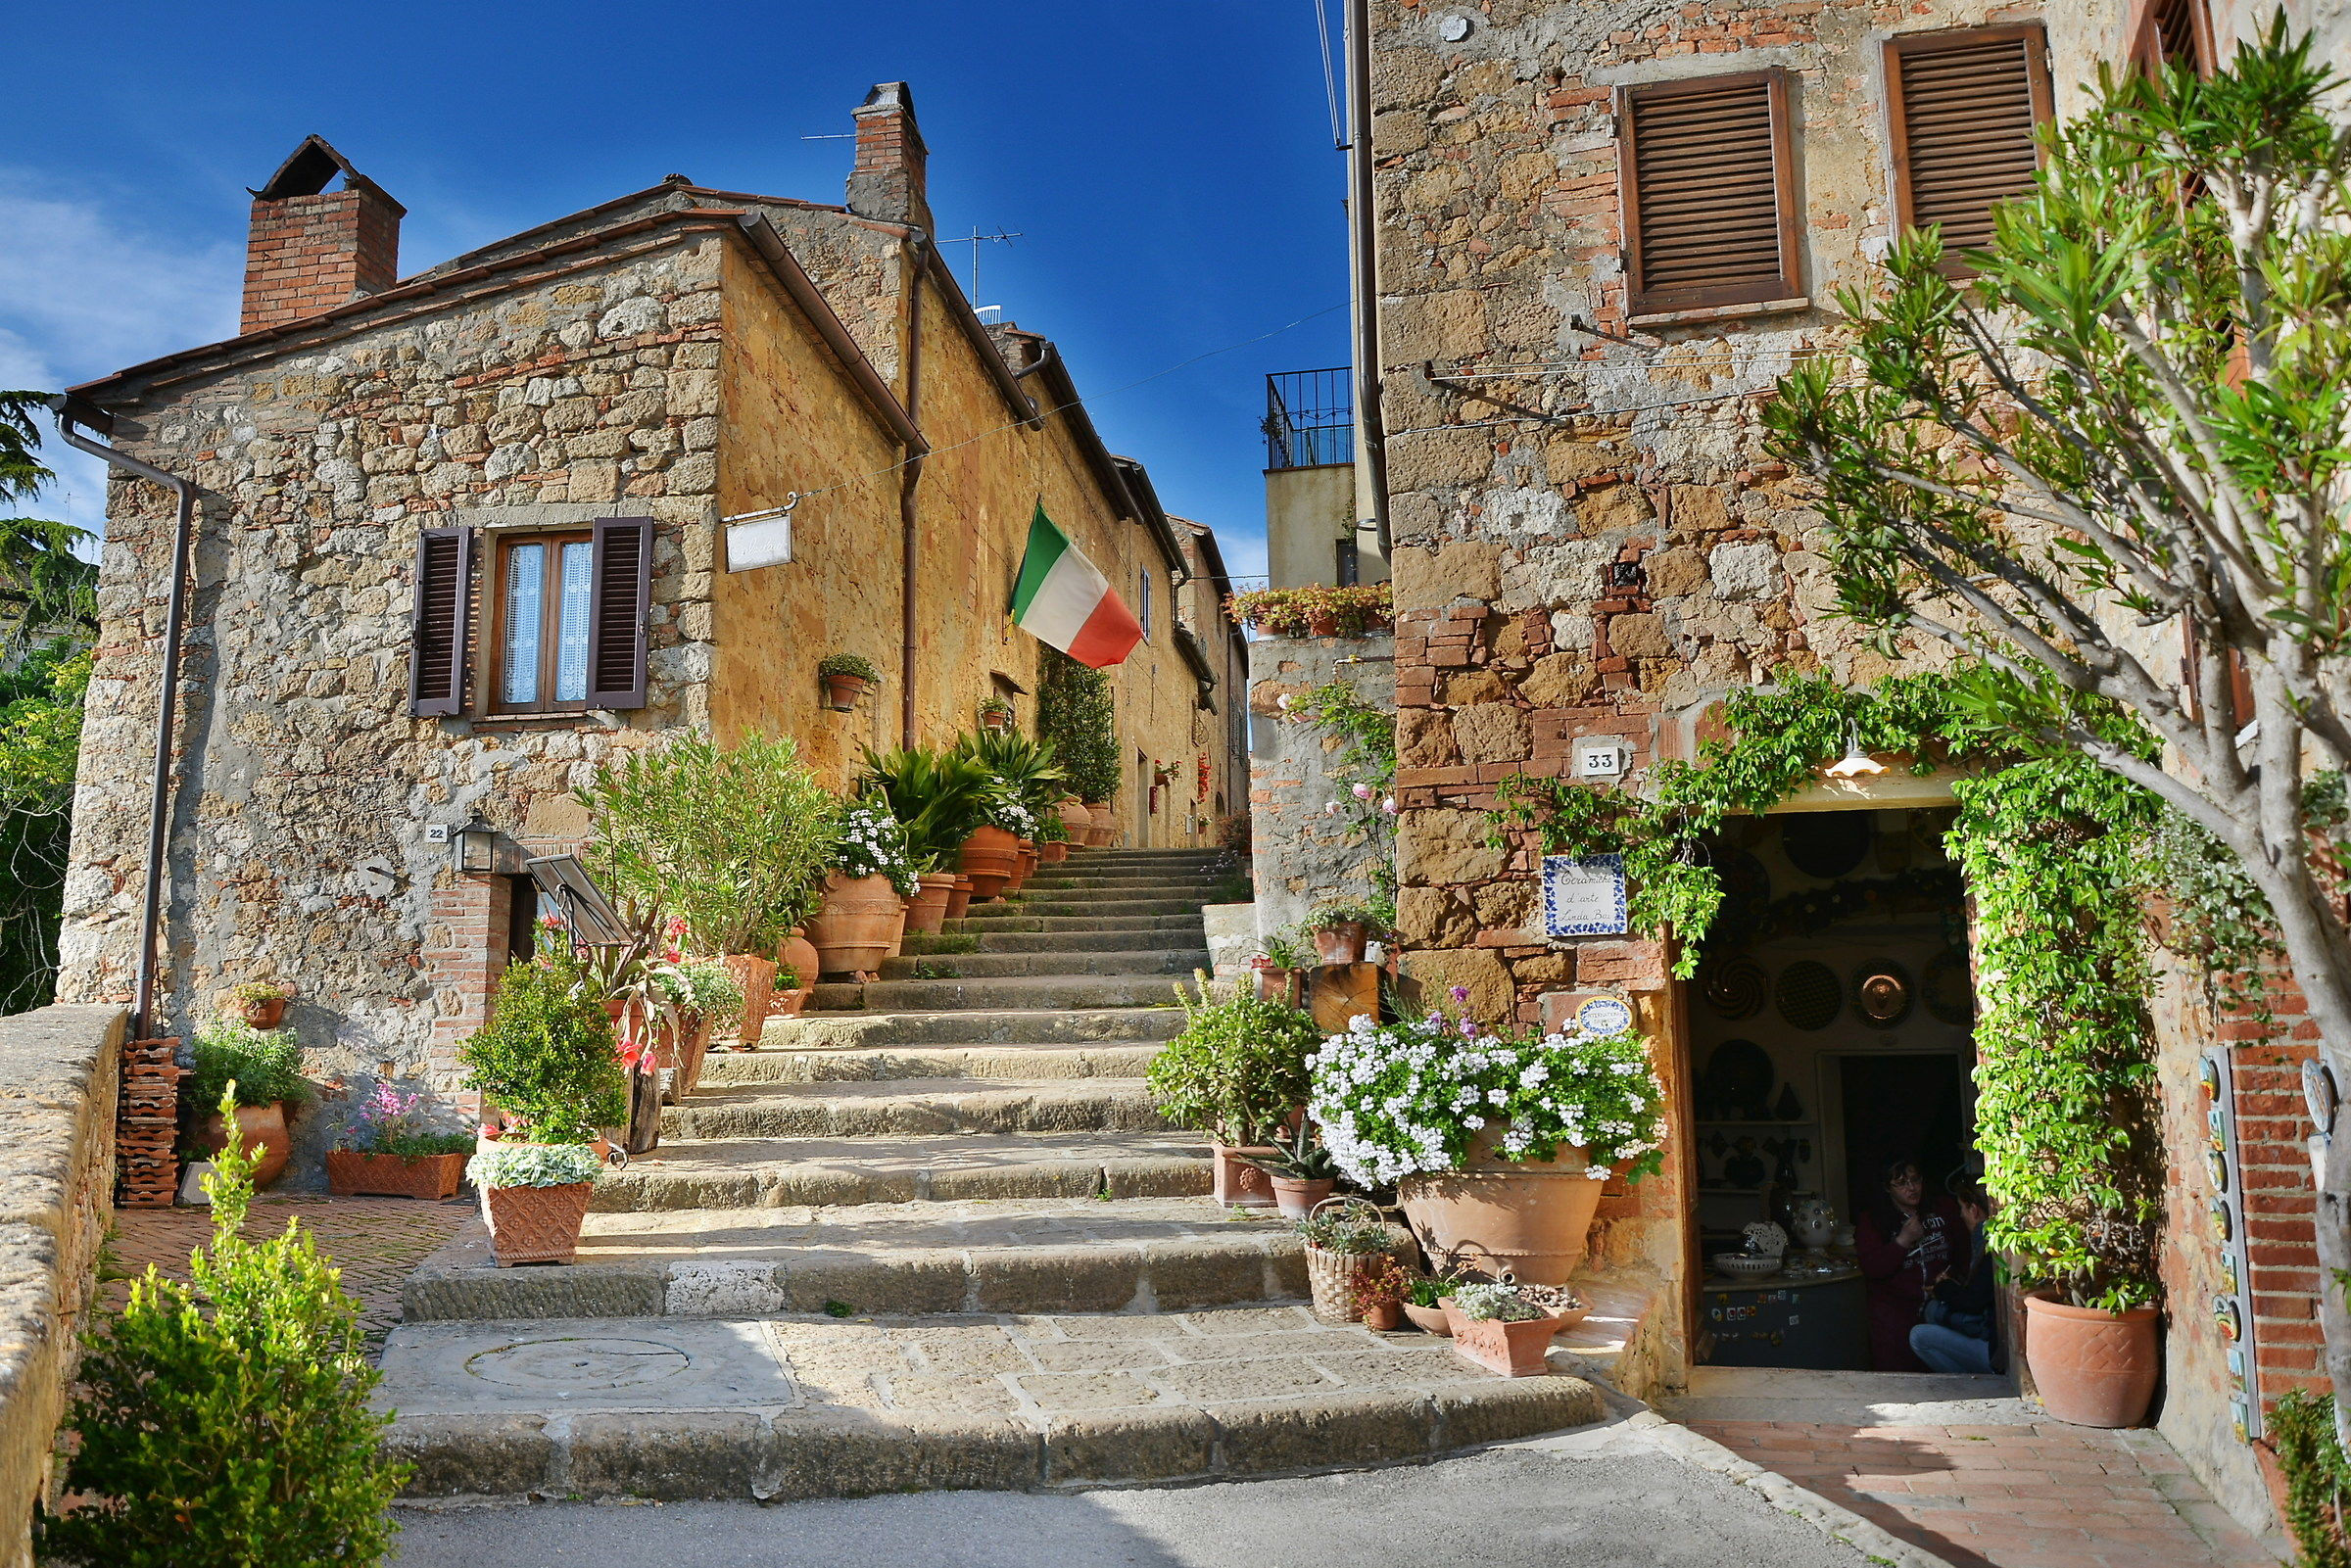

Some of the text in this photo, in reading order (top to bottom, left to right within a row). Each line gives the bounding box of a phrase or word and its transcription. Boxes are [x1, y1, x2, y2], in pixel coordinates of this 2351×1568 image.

[1588, 754, 1613, 769] 33
[429, 829, 444, 838] 22
[1560, 870, 1611, 885] Ceramiche
[1566, 892, 1600, 904] d'arte
[1559, 909, 1589, 922] Linda
